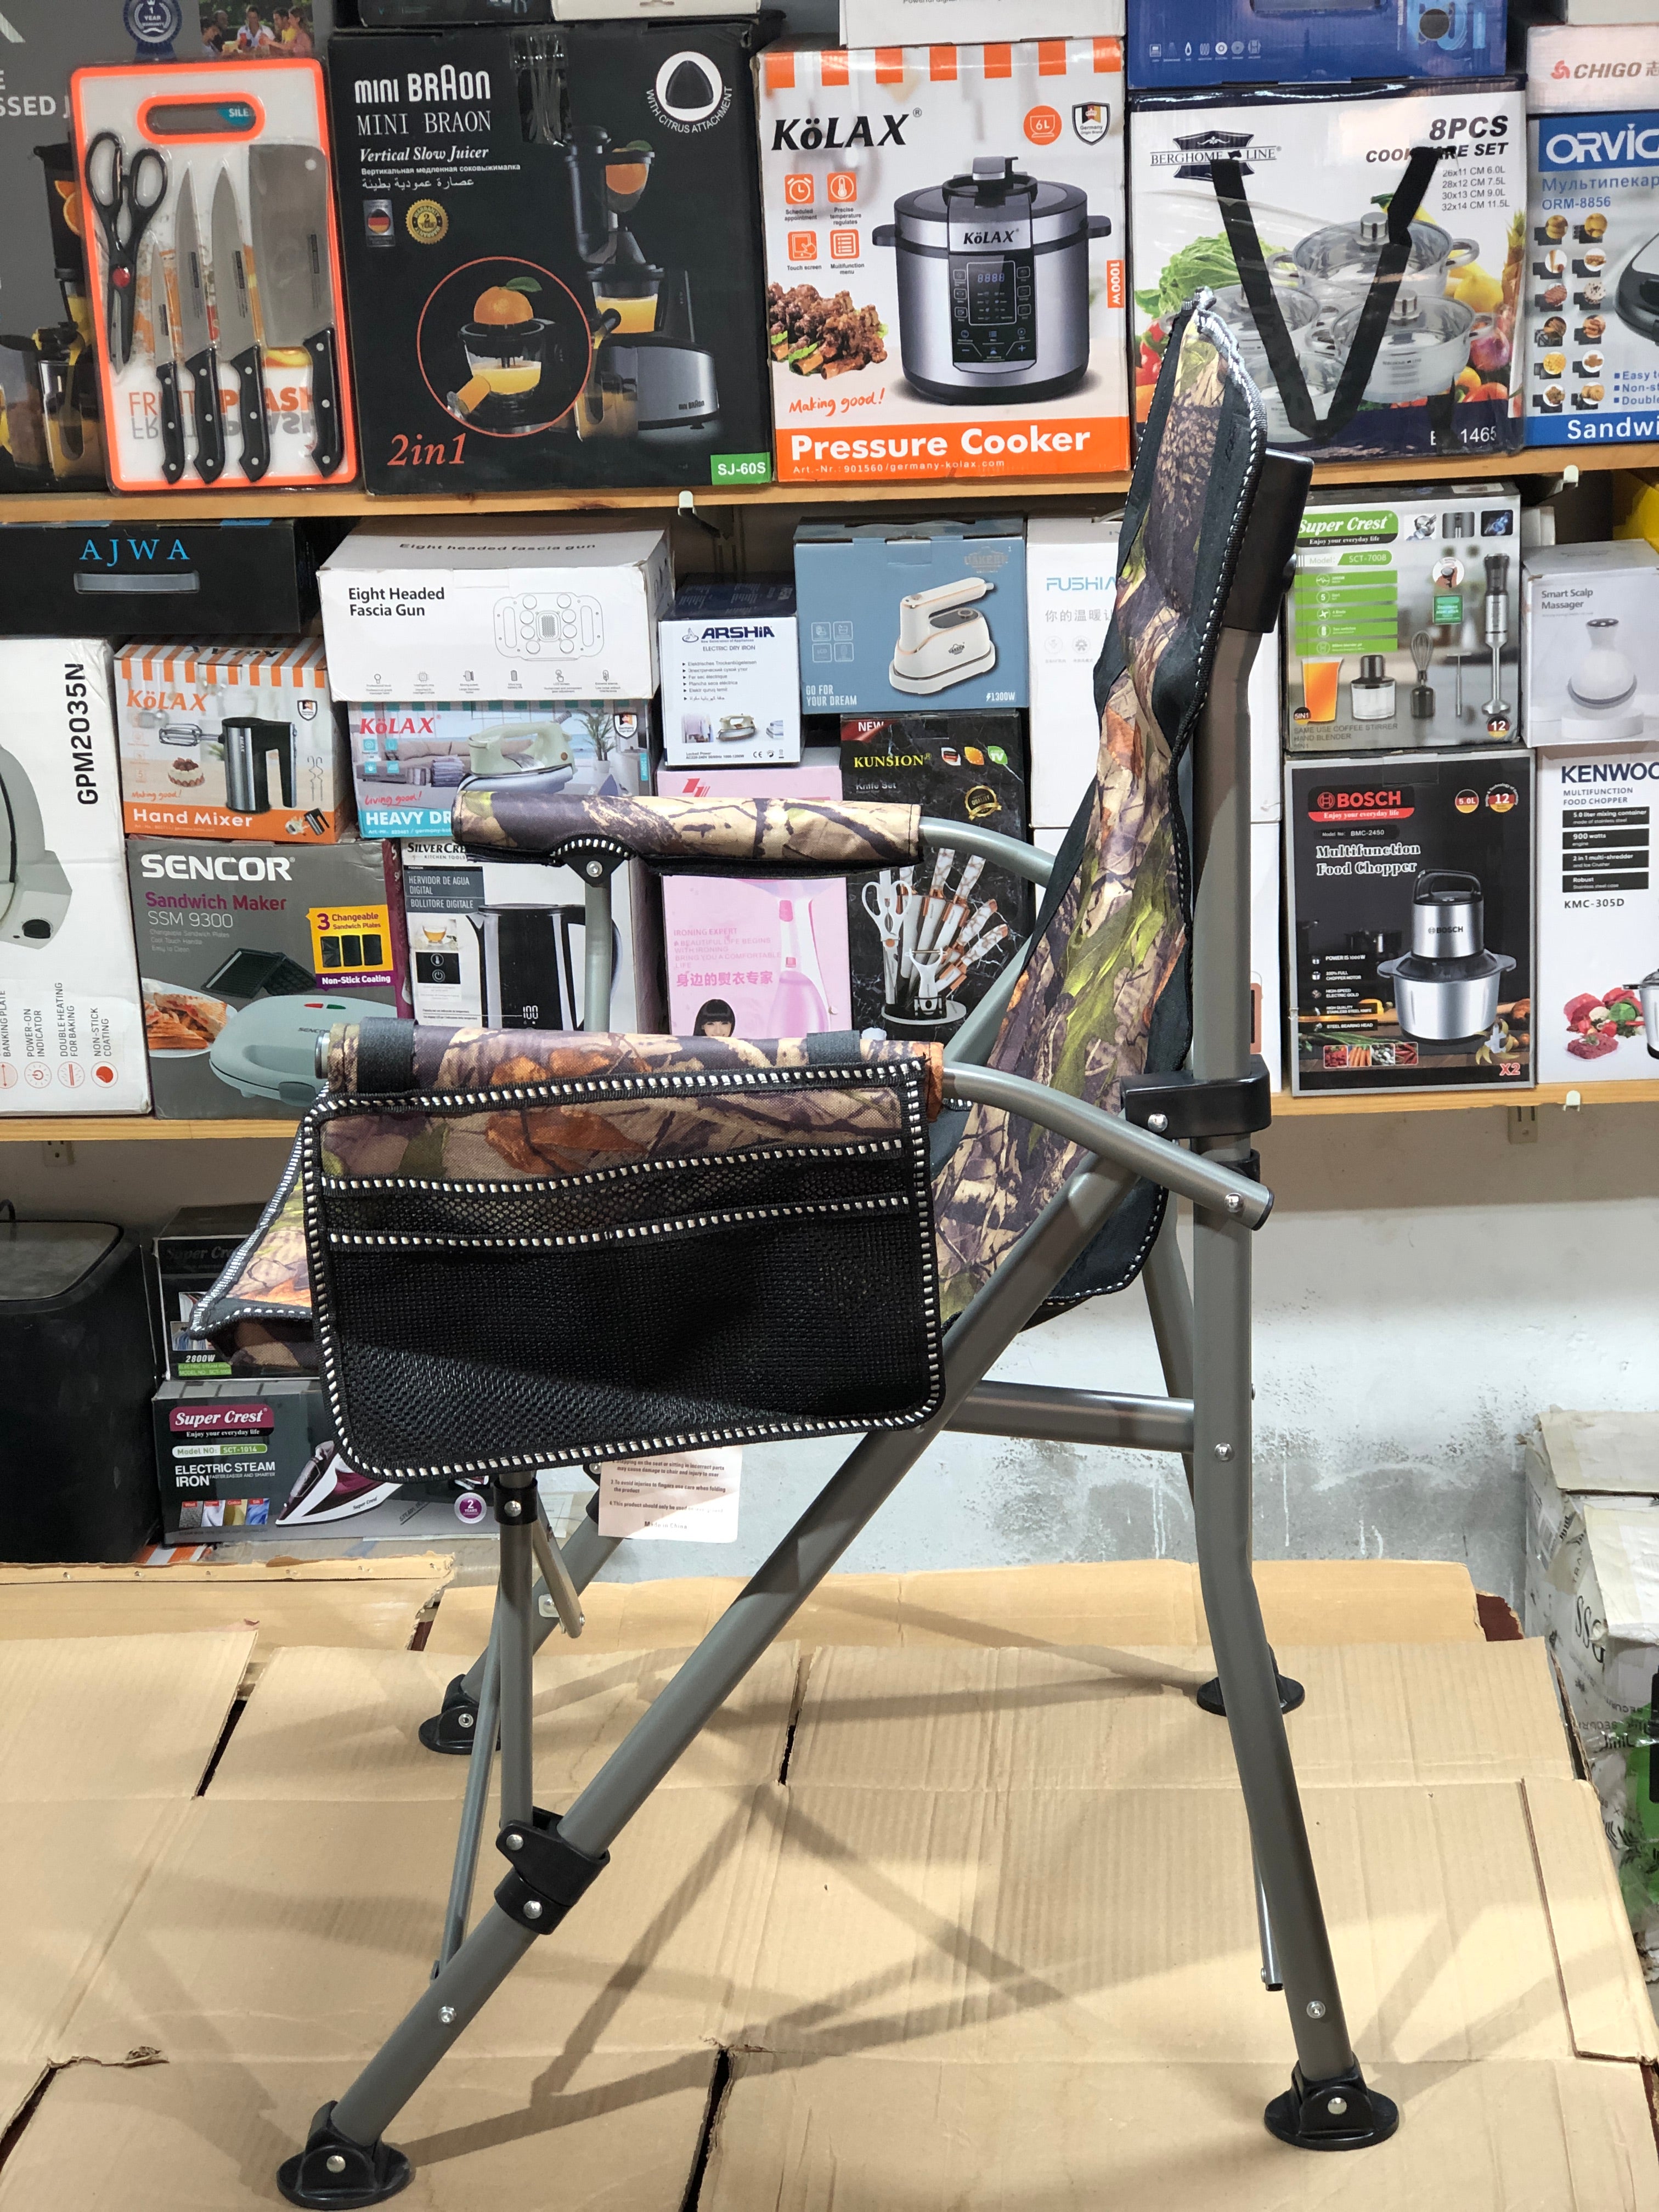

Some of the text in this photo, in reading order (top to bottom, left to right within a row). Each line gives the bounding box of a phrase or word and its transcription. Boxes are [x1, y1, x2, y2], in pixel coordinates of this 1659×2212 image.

[1573, 62, 1642, 79] CHIGO
[646, 86, 732, 133] WITH CITRUS ATTACHMENT
[357, 111, 491, 136] MINI BRAON
[1429, 115, 1508, 140] 8PCS
[360, 146, 488, 162] Vertical Slow Juicer
[1246, 149, 1276, 160] LINE
[1474, 142, 1509, 156] SET
[1487, 166, 1505, 174] 6.0L
[1442, 180, 1468, 188] 28x12
[1488, 177, 1505, 185] 7.5L
[1442, 191, 1468, 200] 30x13
[1442, 202, 1467, 211] 32x14
[1542, 196, 1611, 210] ORM-8856
[1623, 371, 1650, 381] Easy
[789, 387, 885, 417] Making good!
[387, 433, 466, 466] 2in1
[791, 425, 1091, 461] Pressure Cooker
[718, 462, 766, 476] SJ-60S
[844, 463, 883, 473] 901560
[1299, 516, 1388, 535] Super Crest
[1349, 554, 1386, 563] SCT-7008
[348, 586, 445, 602] Eight Headed
[1541, 588, 1593, 599] Smart Scalp
[349, 603, 425, 617] Fascia Gun
[1542, 601, 1584, 611] Massager
[806, 685, 833, 694] GO FOR
[991, 692, 1015, 701] 1300W
[806, 696, 857, 707] YOUR DREAM
[858, 721, 884, 732] NEW
[1491, 720, 1506, 731] 12
[65, 663, 98, 805] GPM2035N
[854, 755, 924, 768] KUNSION
[1495, 793, 1510, 804] 12
[1563, 787, 1633, 796] MULTIFUNCTION
[365, 795, 393, 806] Living
[1337, 791, 1401, 808] BOSCH
[133, 808, 253, 827] Hand Mixer
[366, 811, 423, 825] HEAVY
[1316, 842, 1421, 859] Multifunction
[140, 854, 293, 881] SENCOR
[1317, 861, 1418, 877] Food Chopper
[409, 876, 470, 885] HERVIDOR DE AGUA
[410, 886, 433, 895] DIGITAL
[145, 891, 286, 911] Sandwich Maker
[410, 899, 473, 909] BOLLITORE DIGITALE
[1564, 898, 1624, 909] KMC-305D
[148, 911, 233, 928] SSM 9300
[317, 913, 330, 930] 3
[331, 912, 379, 922] Changeable
[321, 975, 391, 985] Non-Stick Coating
[676, 970, 773, 988] 身边的熨衣专家
[55, 983, 68, 1057] DOUBLE HEATING
[24, 1009, 35, 1057] POWER-ON
[34, 1011, 45, 1057] INDICATOR
[67, 1005, 78, 1057] FOR BAKING
[91, 1008, 101, 1056] NON-STICK
[101, 1018, 111, 1056] COATING
[1499, 1062, 1521, 1076] X2
[185, 1355, 215, 1363] 2800W
[175, 1409, 263, 1428] Super Crest
[175, 1462, 275, 1475] ELECTRIC STEAM
[176, 1475, 210, 1487] IRON
[467, 1499, 474, 1509] 2
